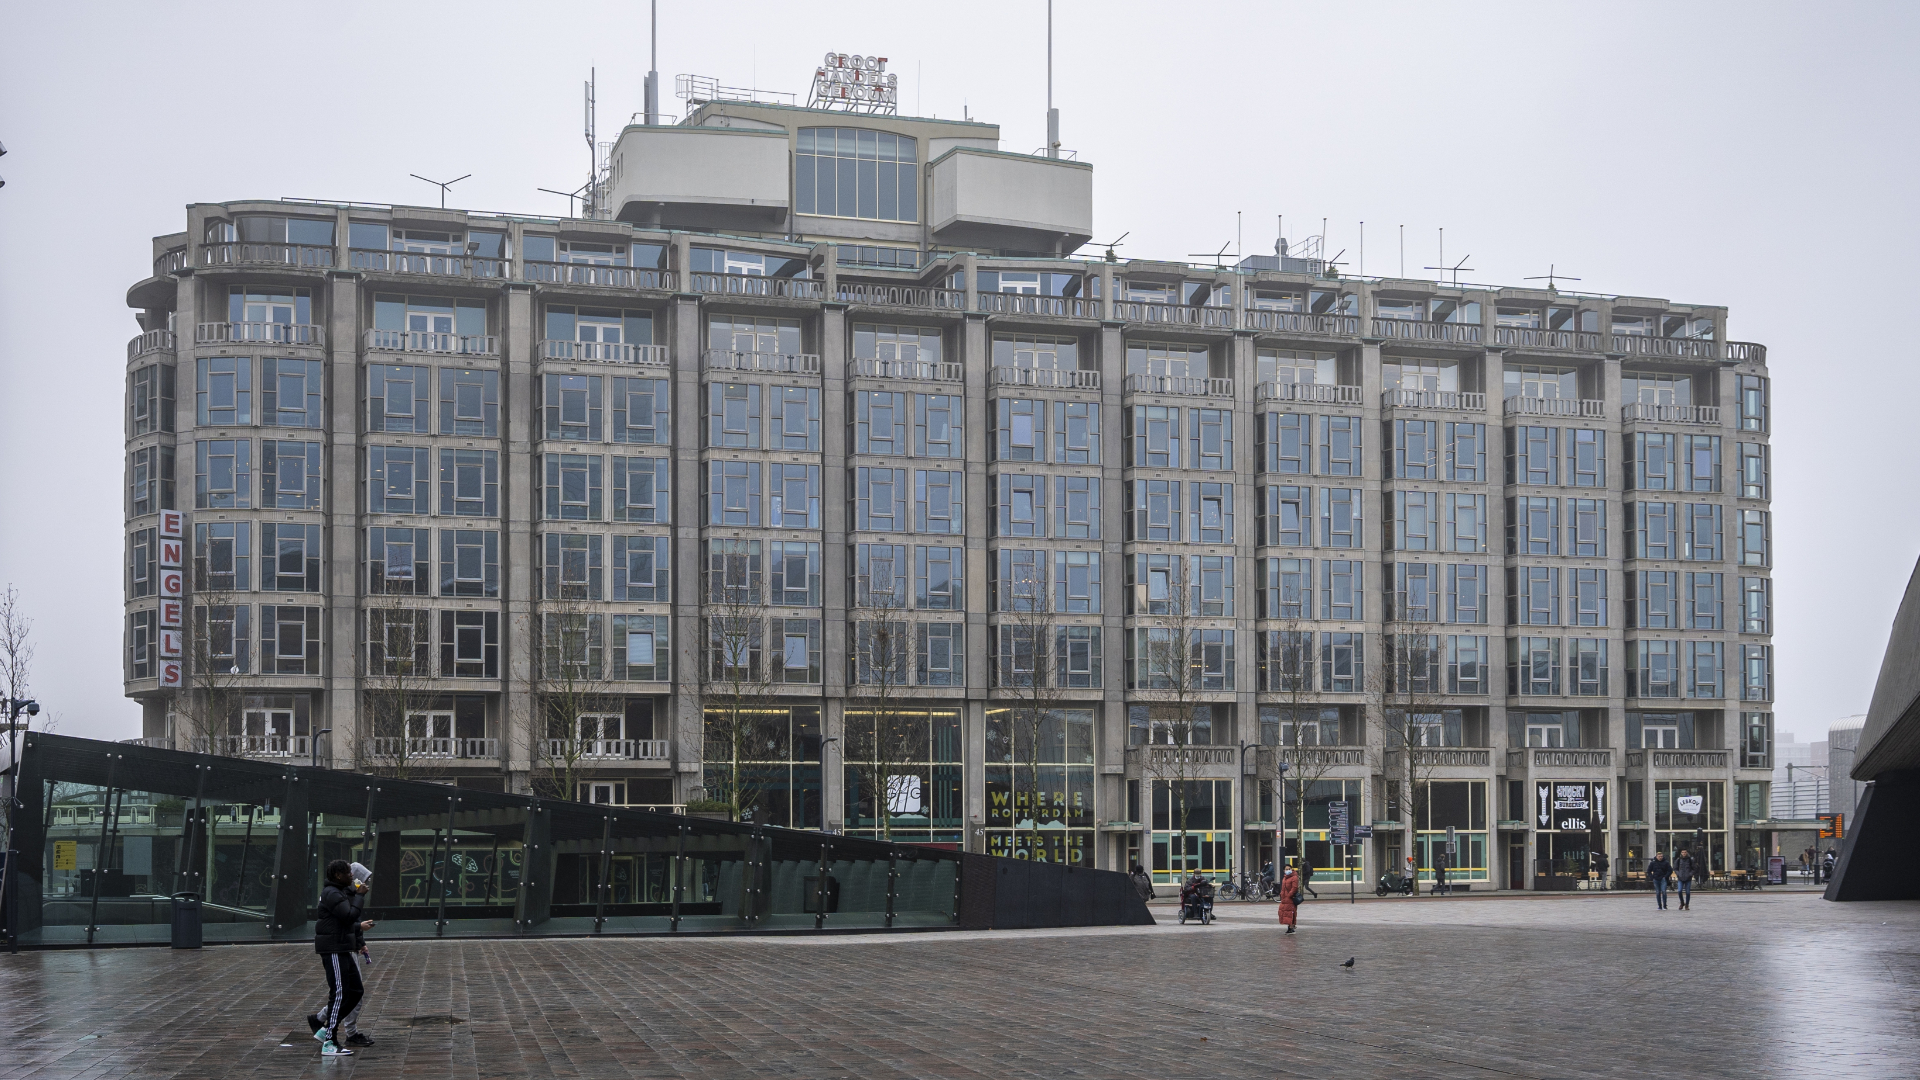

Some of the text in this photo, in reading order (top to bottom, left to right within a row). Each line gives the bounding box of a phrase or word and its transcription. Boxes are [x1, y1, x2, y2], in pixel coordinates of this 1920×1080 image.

[824, 52, 888, 72] GROOT
[817, 66, 897, 88] HANDELS
[817, 82, 897, 102] GEBOUW
[164, 513, 181, 684] ENGELS
[991, 792, 1083, 806] WHERE
[992, 808, 1084, 818] ROTTRDAM
[1561, 818, 1586, 830] ellis
[975, 828, 984, 836] 45
[990, 835, 1084, 847] MEETS THE
